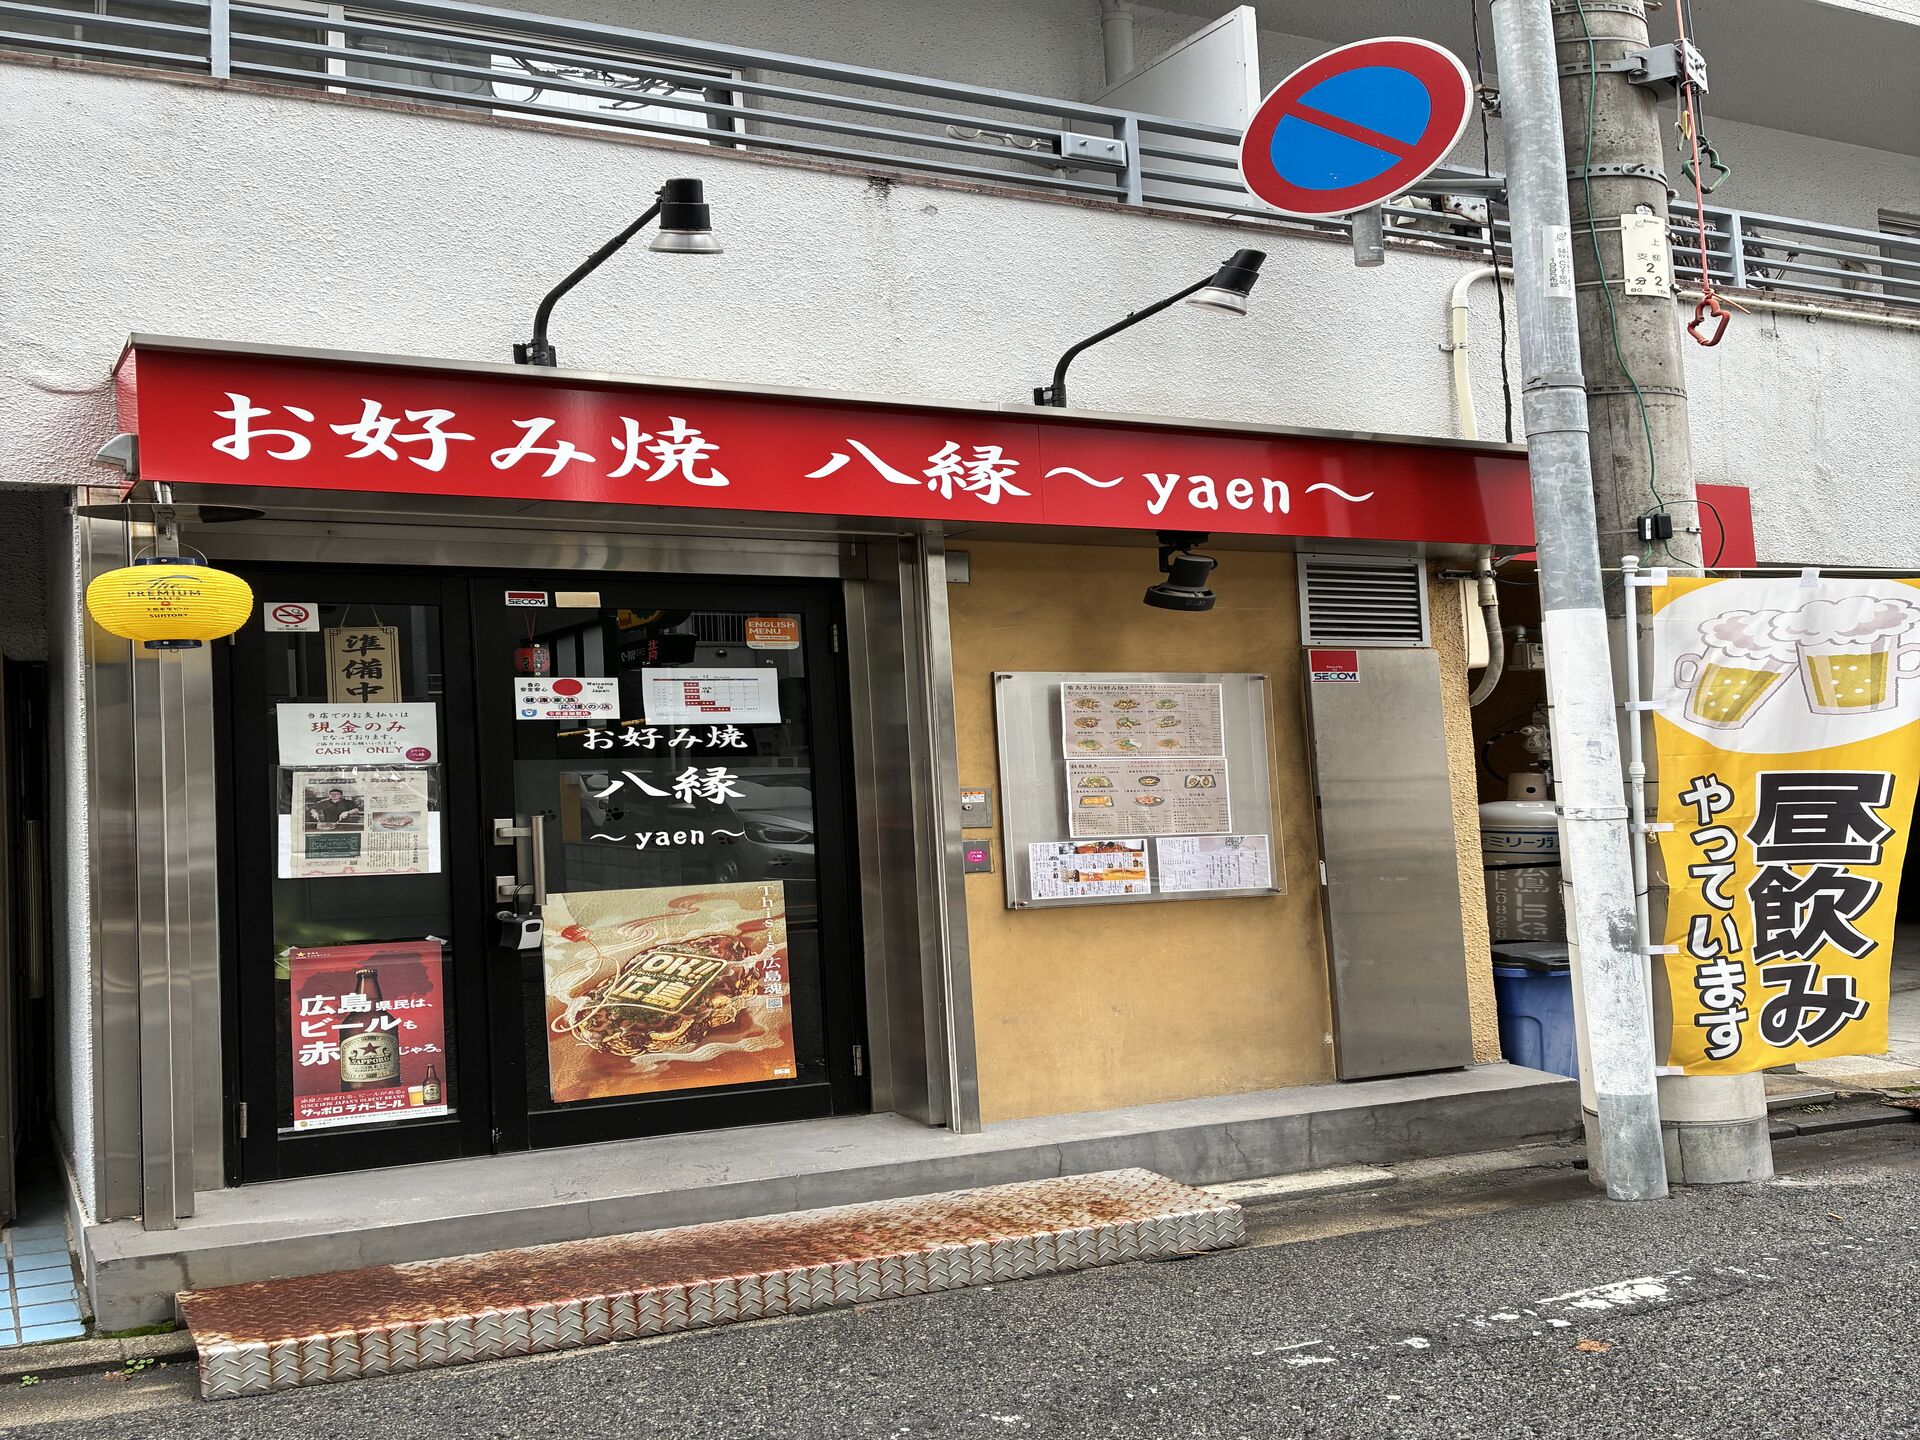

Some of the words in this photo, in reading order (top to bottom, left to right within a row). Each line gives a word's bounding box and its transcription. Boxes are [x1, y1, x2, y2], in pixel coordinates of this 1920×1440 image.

[212, 391, 730, 487] お好み焼
[804, 438, 1032, 506] 八縁
[127, 589, 201, 597] PREMIUM
[748, 620, 795, 628] ENGLISH
[342, 634, 385, 703] 準備中
[1314, 672, 1356, 680] SECOM
[310, 720, 406, 734] 現金のみ
[583, 724, 748, 750] お好み焼
[366, 746, 404, 754] ONLY
[593, 766, 746, 805] 八縁
[1484, 836, 1559, 849] ミリーガ
[1679, 773, 1751, 1061] やっています
[1745, 771, 1895, 1048] 昼飲み
[642, 954, 723, 980] OK!!
[762, 957, 782, 995] 広島魂
[301, 1015, 418, 1038] ビールも
[351, 1056, 390, 1066] SAPPORO
[300, 1105, 343, 1117] サッポロ
[345, 1100, 405, 1112] ラガービール
